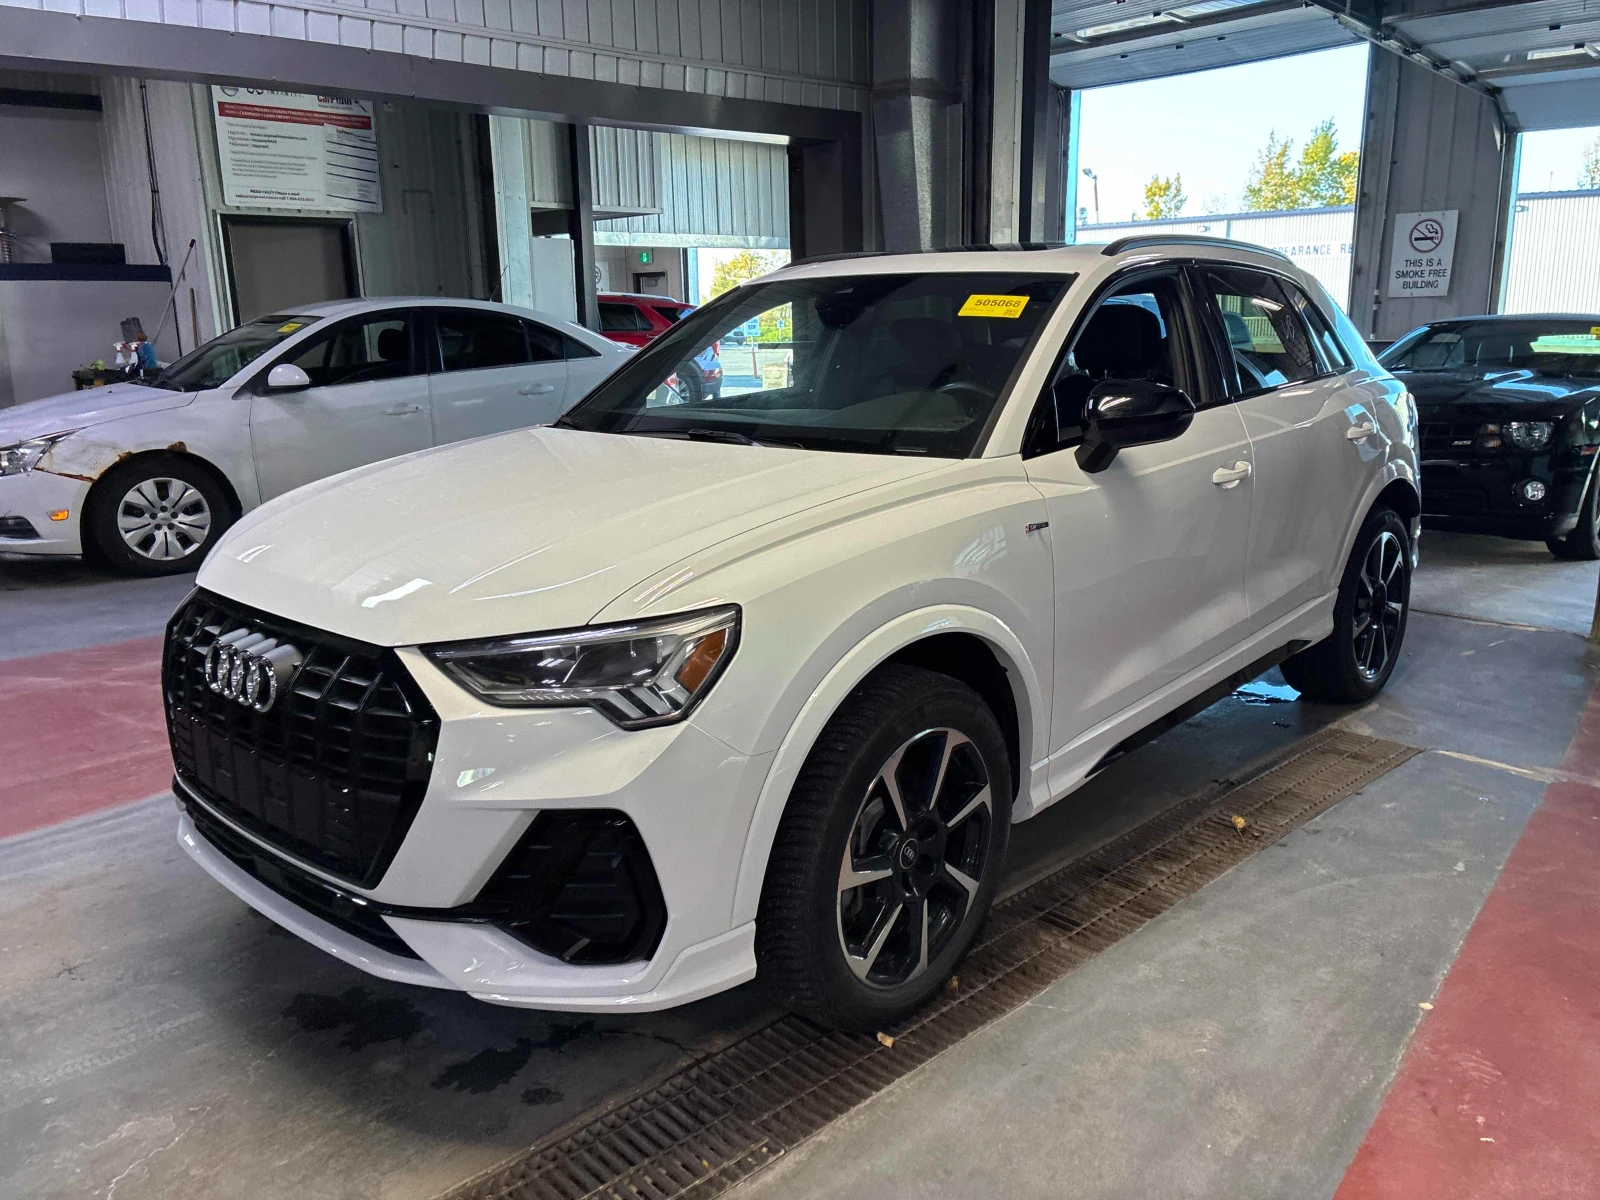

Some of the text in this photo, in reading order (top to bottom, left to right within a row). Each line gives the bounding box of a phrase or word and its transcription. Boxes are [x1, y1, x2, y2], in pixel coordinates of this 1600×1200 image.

[1404, 258, 1442, 268] THIS IS A
[1395, 268, 1447, 279] SMOKE FREE
[1402, 280, 1439, 289] BUILDING
[974, 299, 1021, 308] 505068
